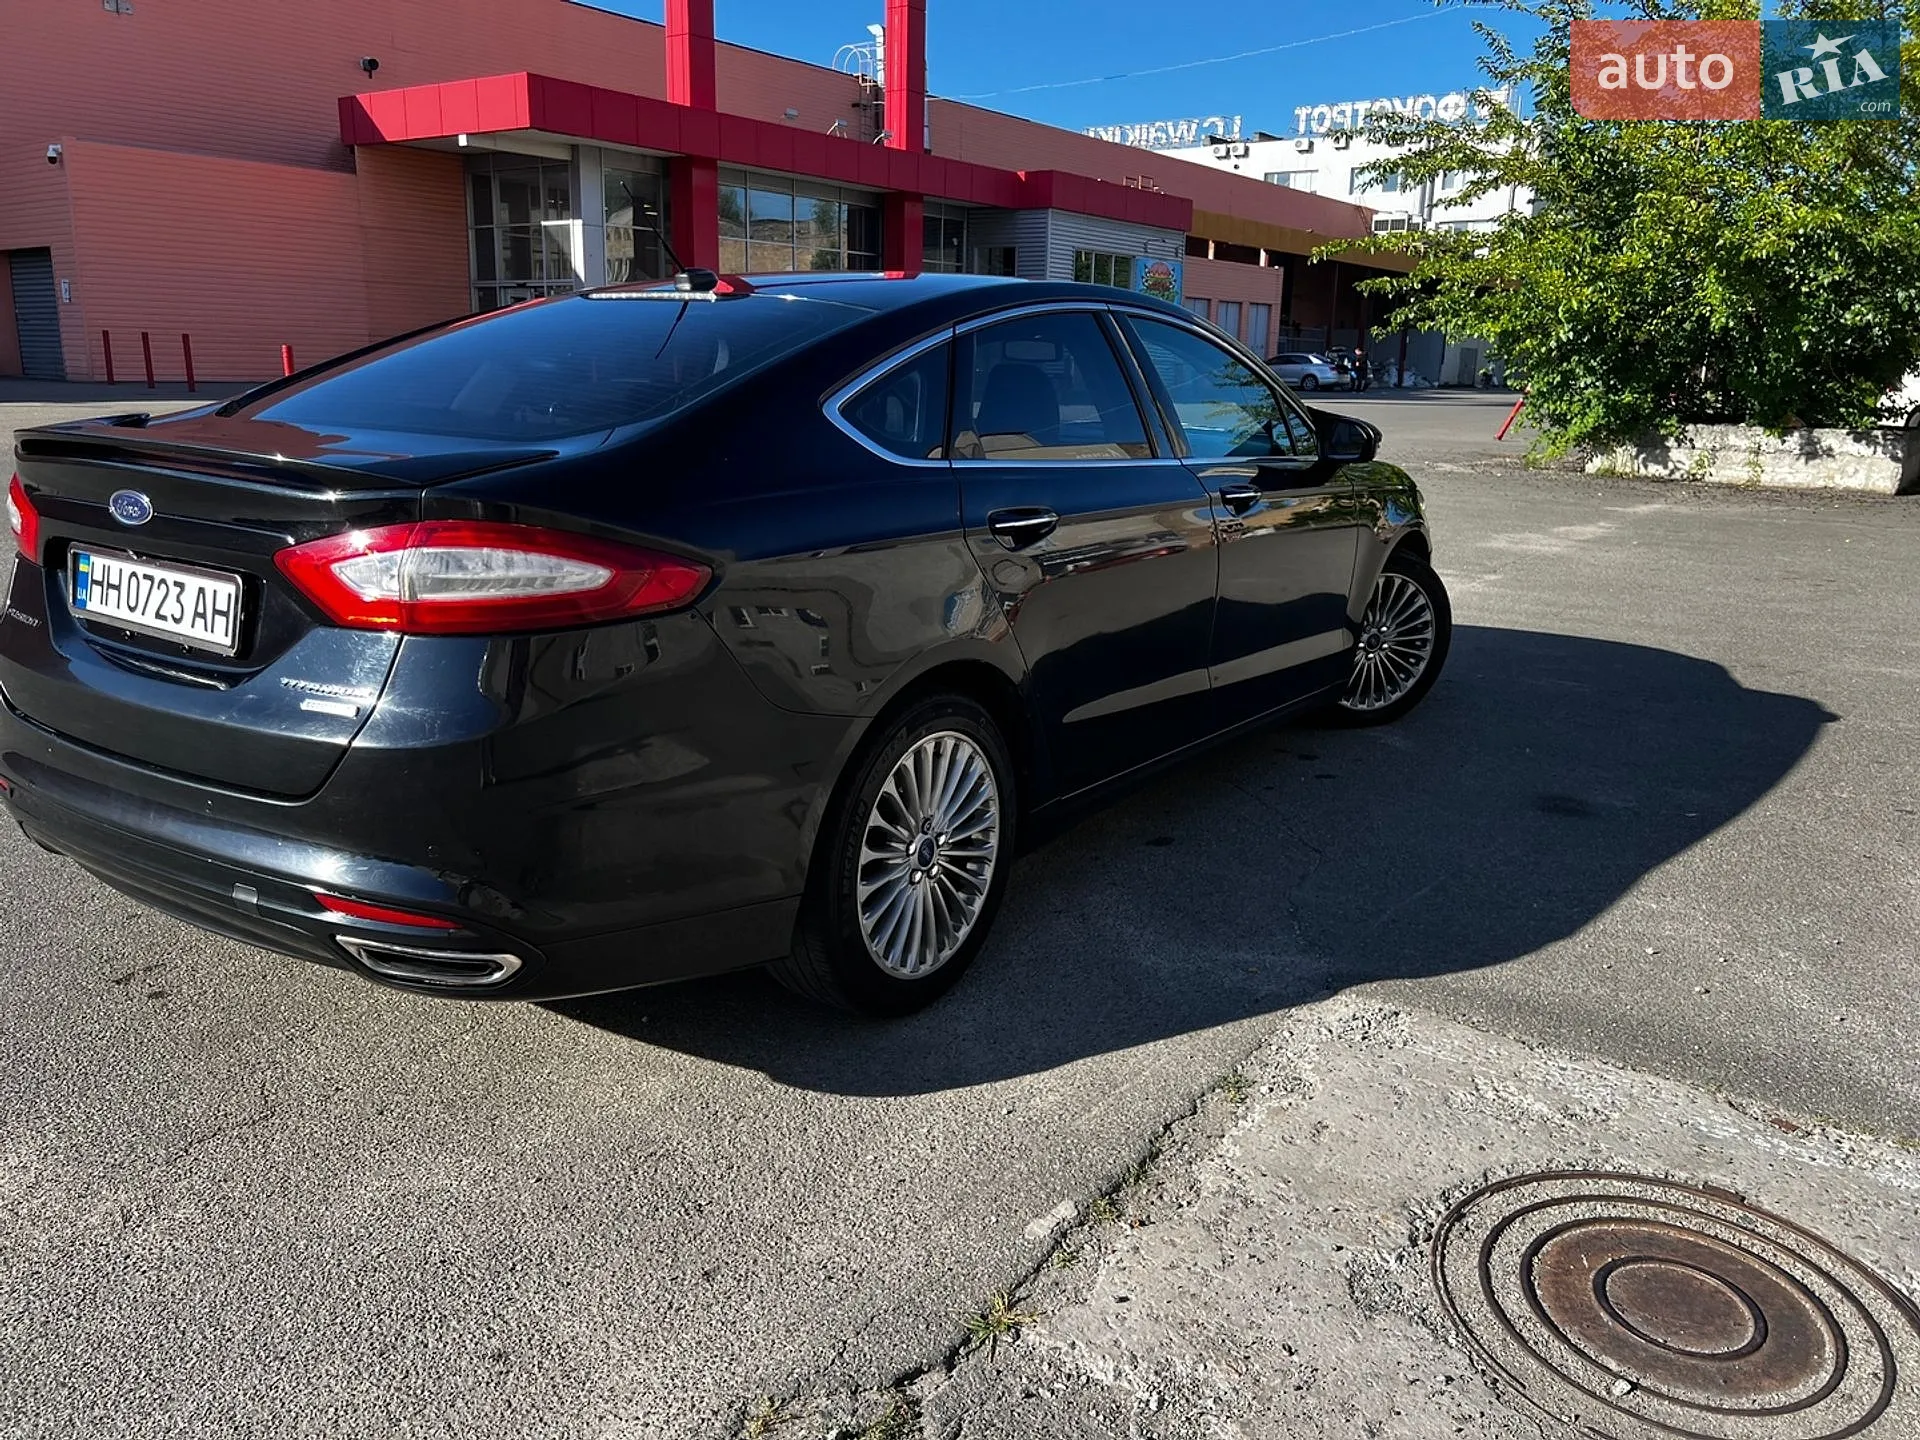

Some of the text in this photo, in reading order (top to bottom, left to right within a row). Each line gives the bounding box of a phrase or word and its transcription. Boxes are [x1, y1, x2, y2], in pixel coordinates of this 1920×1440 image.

[77, 588, 87, 601] UA
[89, 561, 232, 638] HH 0723 AH
